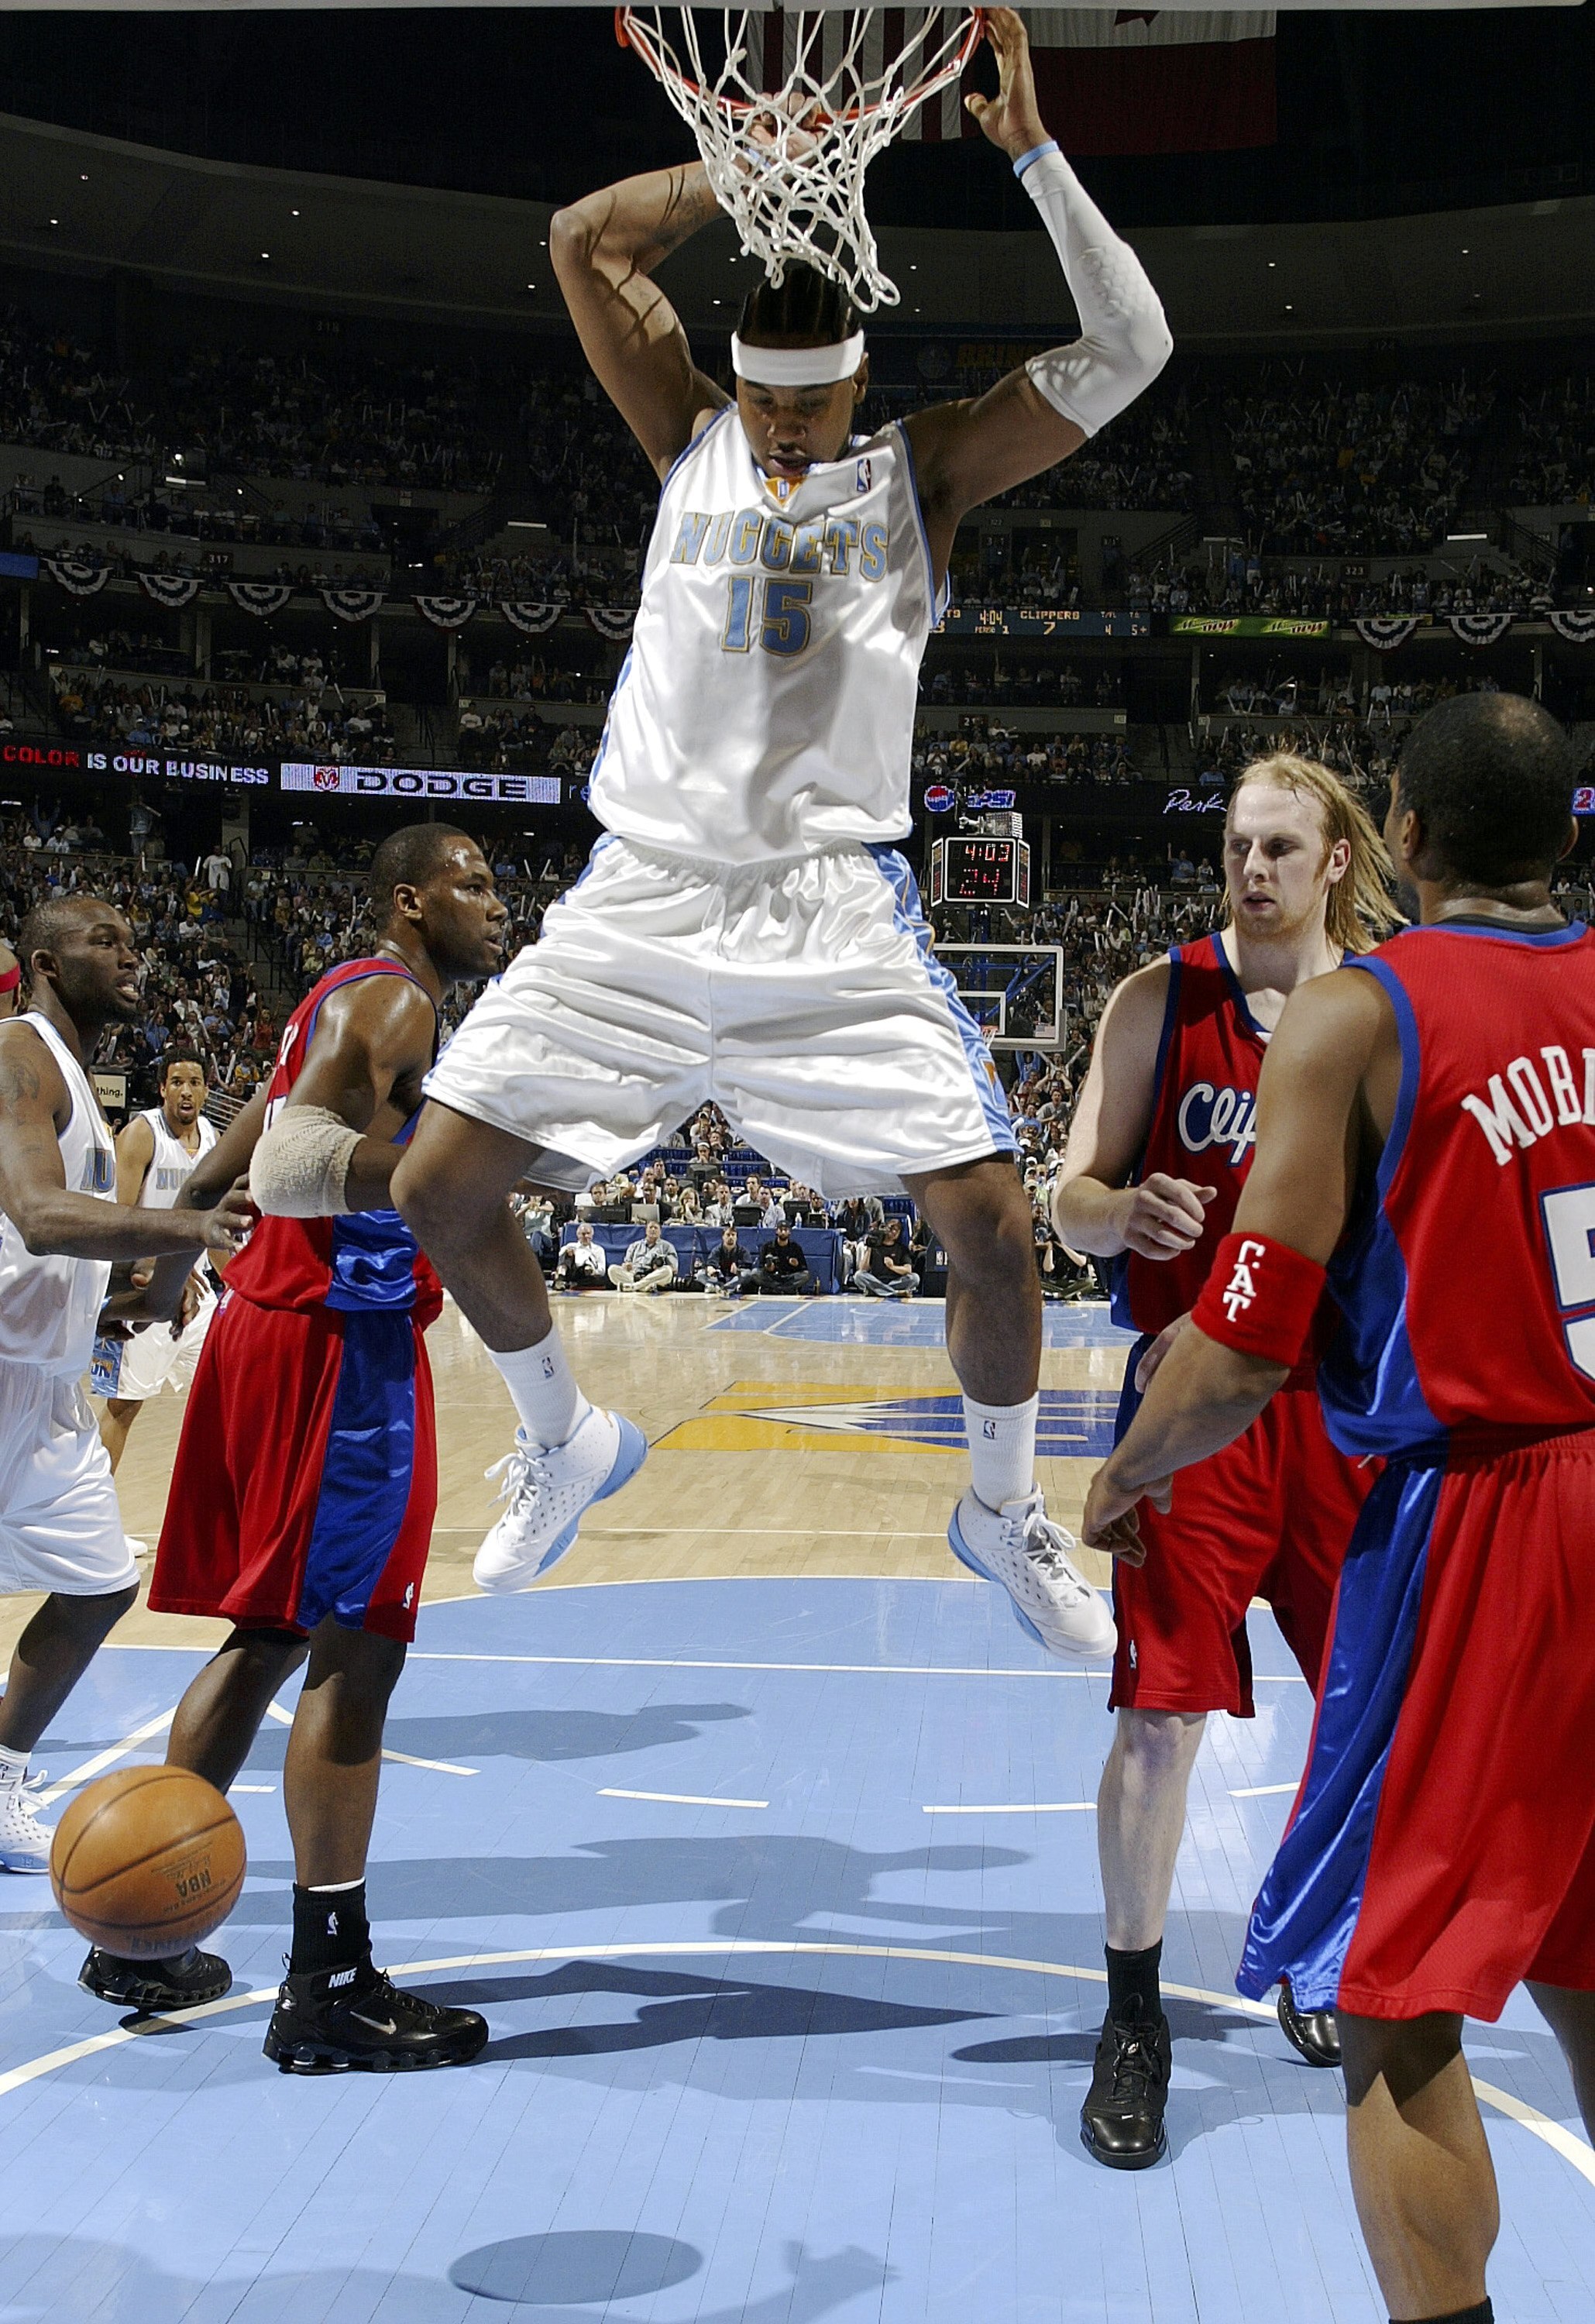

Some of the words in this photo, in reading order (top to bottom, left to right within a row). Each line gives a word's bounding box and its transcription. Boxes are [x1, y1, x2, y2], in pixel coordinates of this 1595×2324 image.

[670, 507, 889, 583] NUGGETS
[209, 554, 229, 563] 317
[721, 576, 813, 657] 15
[980, 609, 1002, 625] 4:04
[1020, 610, 1080, 621] CLIPPERS
[1043, 621, 1056, 635] 7
[1105, 624, 1112, 635] 4
[2, 745, 80, 767] COLOR
[88, 752, 107, 770] IS
[113, 755, 160, 775] OUR
[166, 761, 270, 785] BUSINESS
[356, 772, 527, 799] DODGE
[965, 844, 1010, 861] 4:03
[959, 868, 1000, 896] 24
[176, 1869, 211, 1897] NBA
[328, 1967, 358, 1989] NIKE
